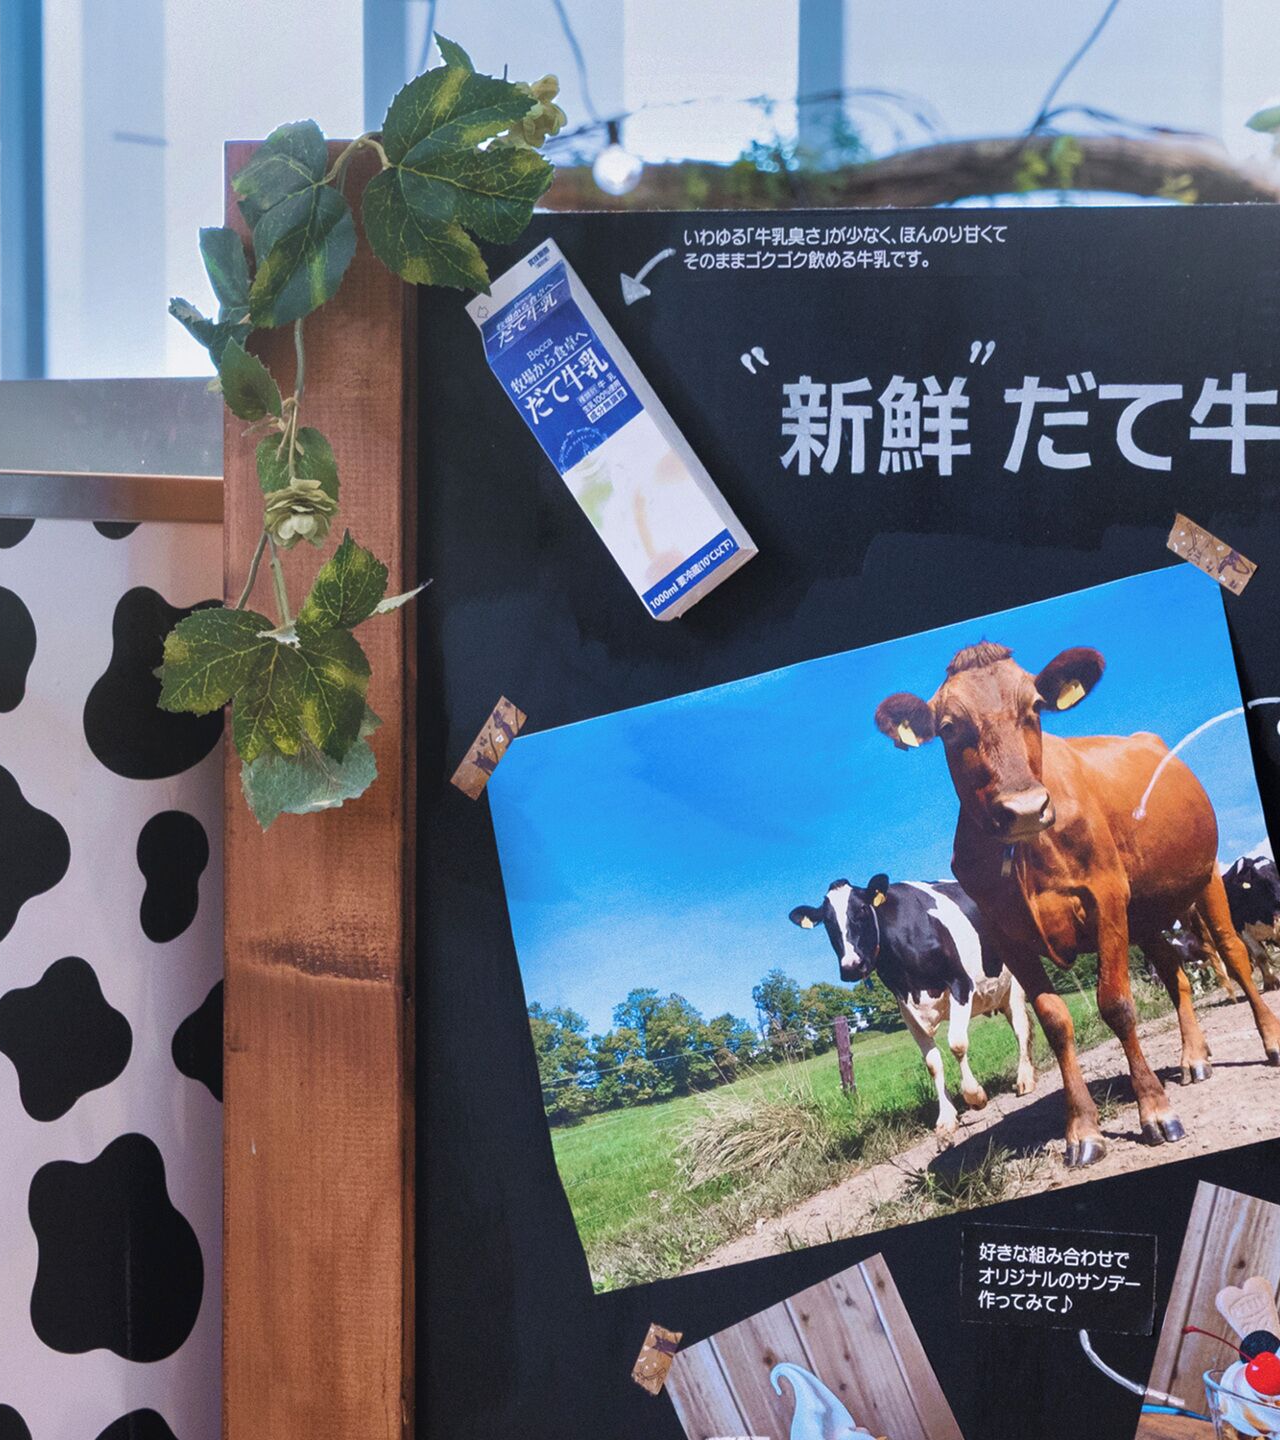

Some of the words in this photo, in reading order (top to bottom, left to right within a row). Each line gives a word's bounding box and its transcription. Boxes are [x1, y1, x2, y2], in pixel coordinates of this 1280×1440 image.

[683, 225, 1008, 247] いわゆる「牛乳臭さ」が少なく、ほんのり甘くて
[683, 250, 931, 271] そのままゴクゴク飲める牛乳です。
[526, 338, 554, 361] Bocca
[510, 332, 588, 394] 牧場から食卓へ
[524, 346, 609, 424] だて牛乳
[649, 583, 679, 609] 1000ml
[978, 1242, 1130, 1269] 好きな組み合わせで
[978, 1266, 1142, 1292] オリジナルのサンデー
